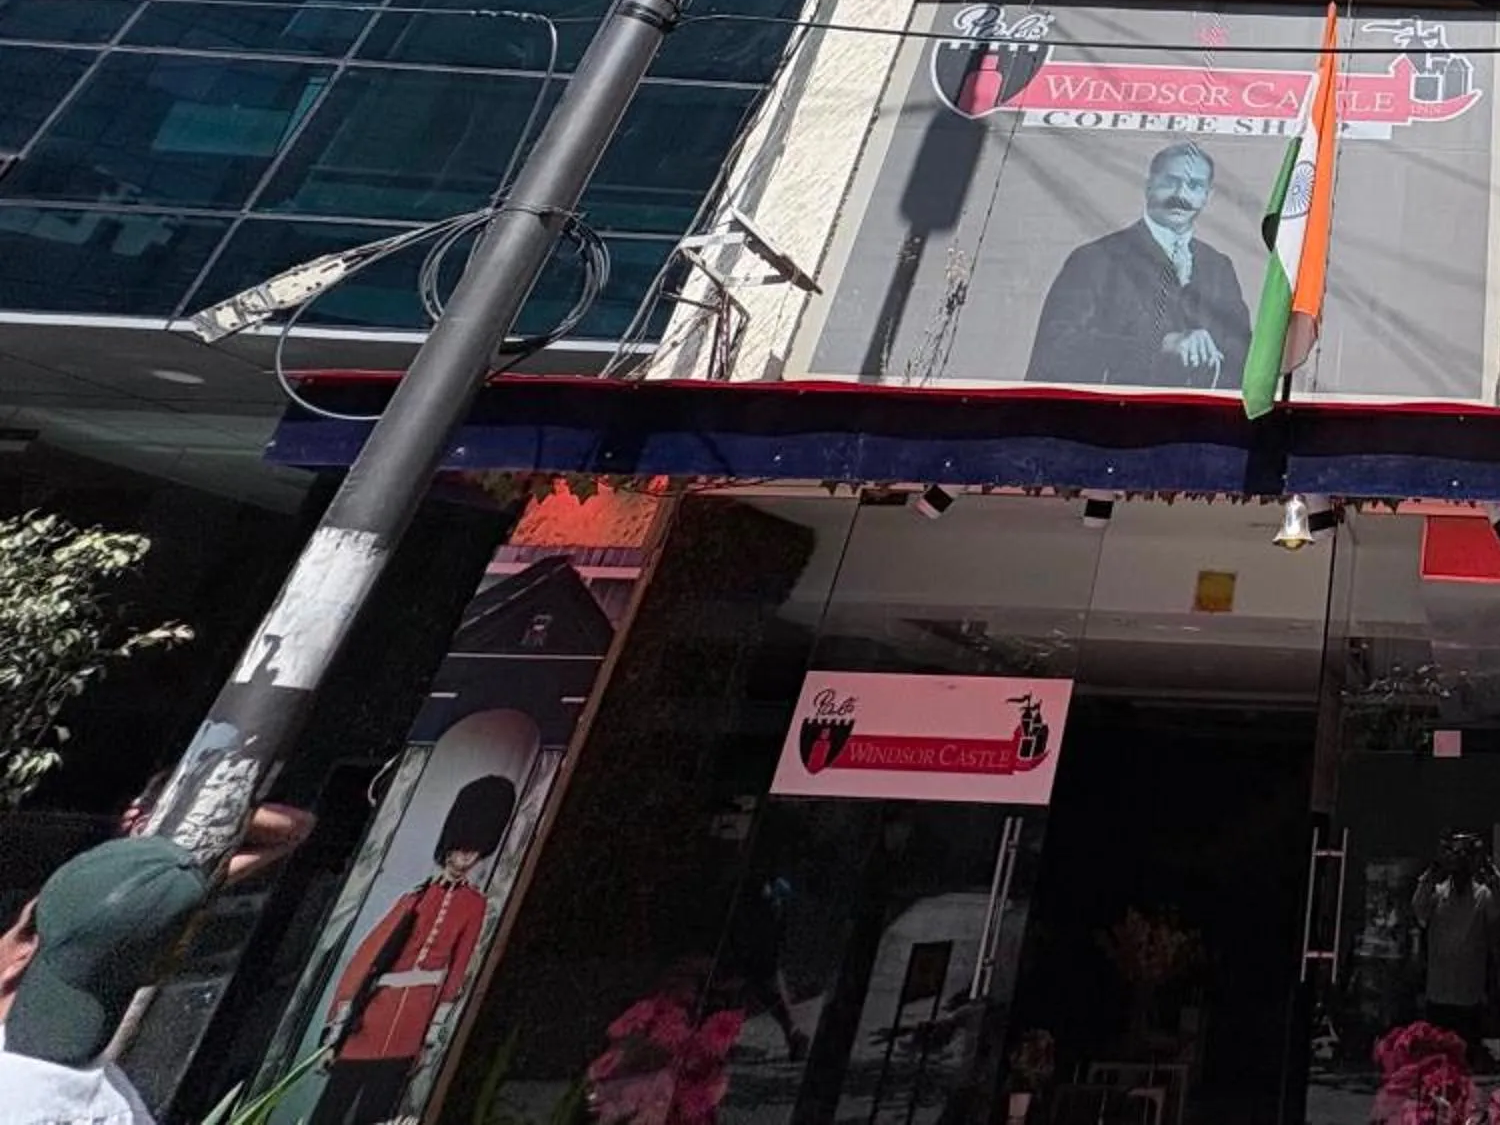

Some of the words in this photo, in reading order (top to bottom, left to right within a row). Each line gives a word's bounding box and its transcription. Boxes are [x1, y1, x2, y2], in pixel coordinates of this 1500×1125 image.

[1045, 74, 1231, 109] WINDSOR
[1241, 80, 1396, 113] CATLE
[1042, 110, 1221, 132] COFFEE
[1234, 118, 1350, 134] SH
[849, 742, 935, 766] WINDSOR
[938, 743, 1012, 768] CASTLE
